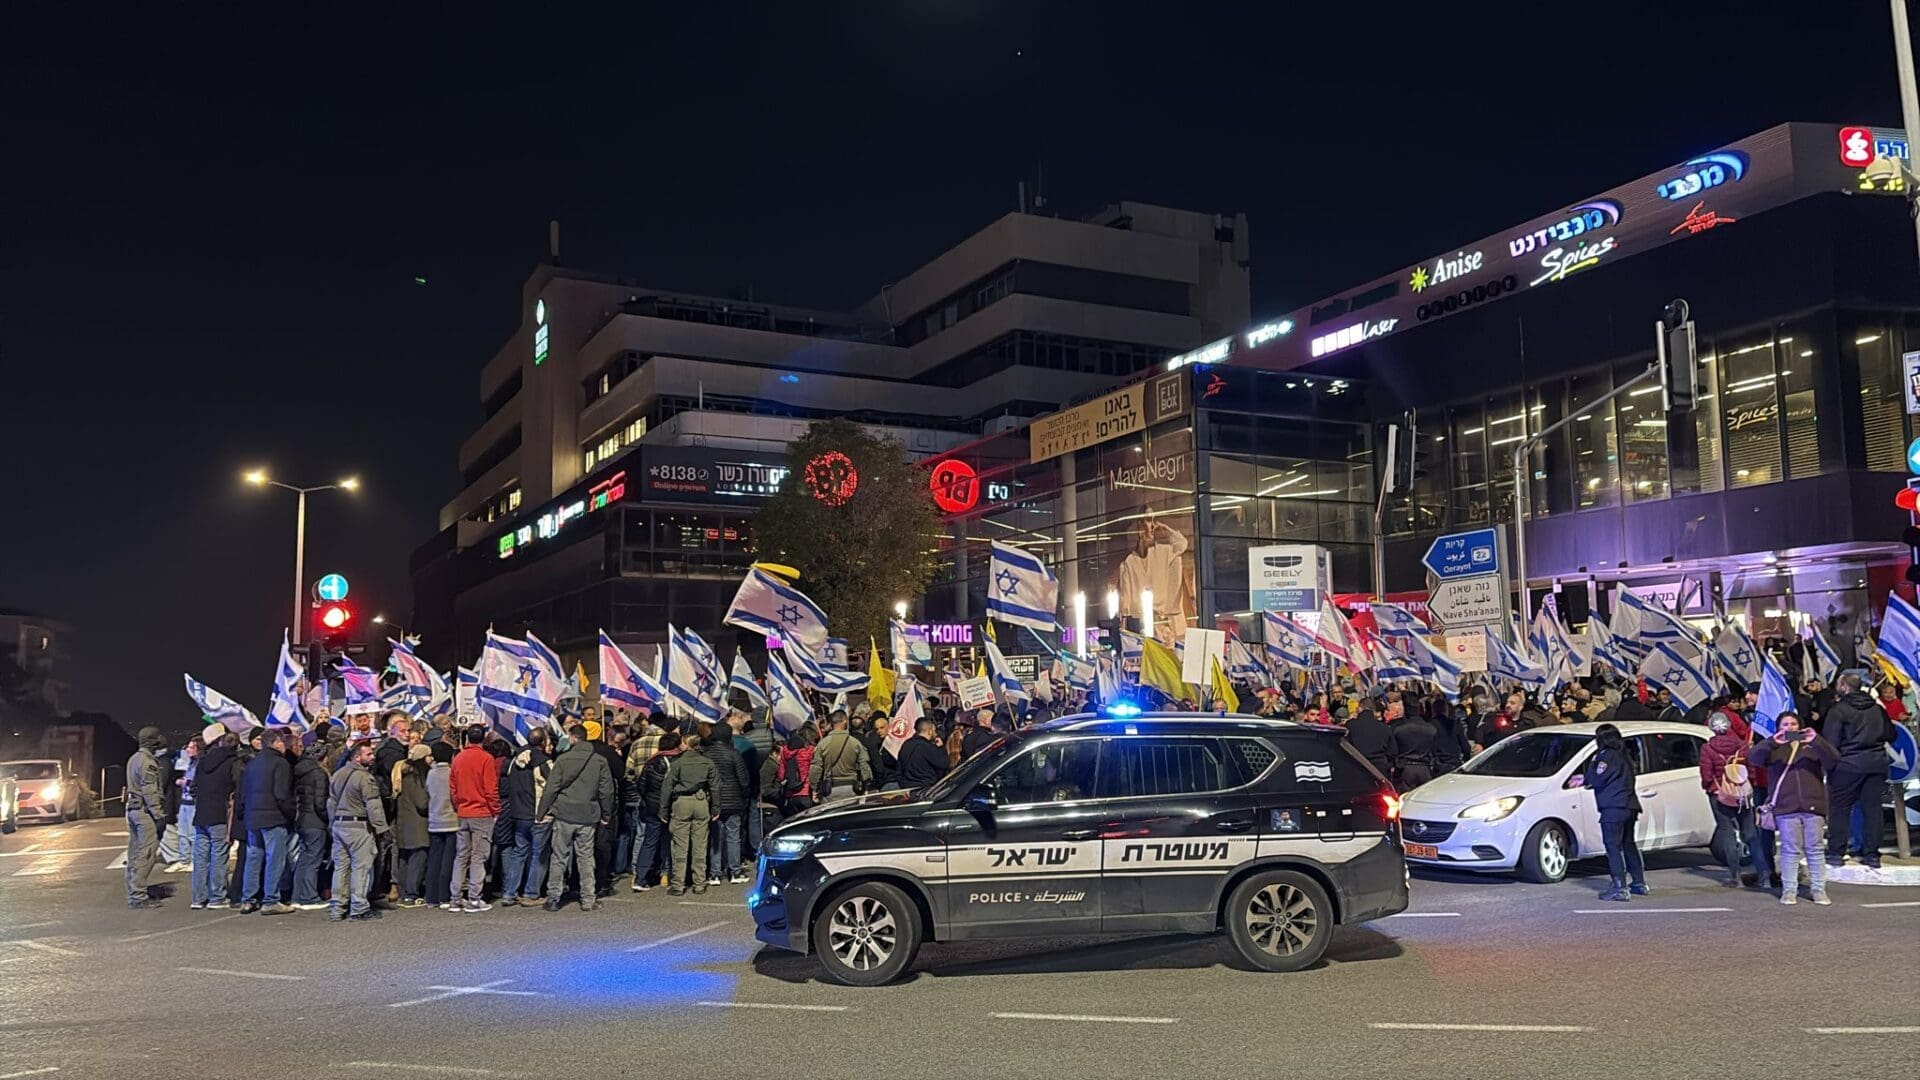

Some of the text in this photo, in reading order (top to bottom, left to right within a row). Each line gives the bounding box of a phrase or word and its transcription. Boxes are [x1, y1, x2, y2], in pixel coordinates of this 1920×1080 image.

[1657, 166, 1724, 200] מכבי
[1509, 210, 1604, 257] מכבידנט
[1430, 251, 1483, 286] Anise
[1530, 236, 1616, 286] Spices
[1160, 383, 1177, 398] FIT
[1104, 394, 1131, 416] באנו
[1160, 396, 1178, 411] BOX
[1096, 409, 1137, 439] להרים!
[716, 466, 743, 482] כשר
[1445, 540, 1465, 549] קריות
[1475, 551, 1487, 560] 22
[1263, 570, 1303, 578] GEELY
[1443, 563, 1471, 573] Qerayot
[1449, 582, 1490, 596] נוה שאנן
[1443, 610, 1464, 619] Nave
[932, 624, 972, 643] KONG
[987, 843, 1229, 867] משטרת ישראל
[969, 890, 1086, 904] POLICE الشرطة
